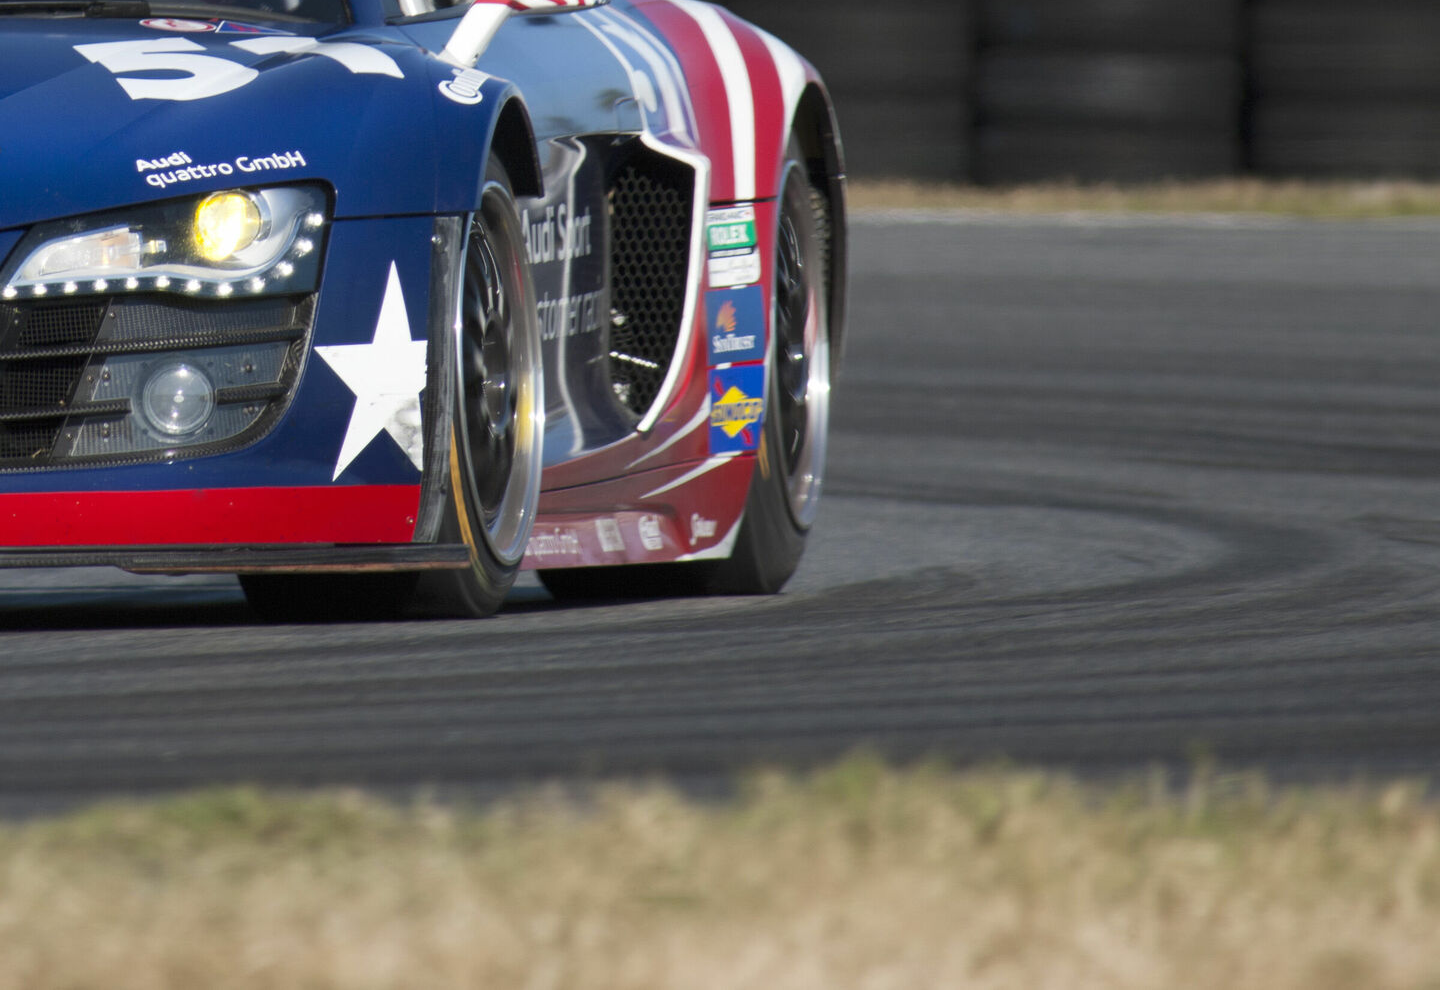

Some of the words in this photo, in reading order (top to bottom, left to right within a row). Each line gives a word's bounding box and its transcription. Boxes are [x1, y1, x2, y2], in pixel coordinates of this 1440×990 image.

[136, 151, 192, 172] Audi
[146, 163, 233, 188] quattro
[236, 150, 307, 173] GmbH
